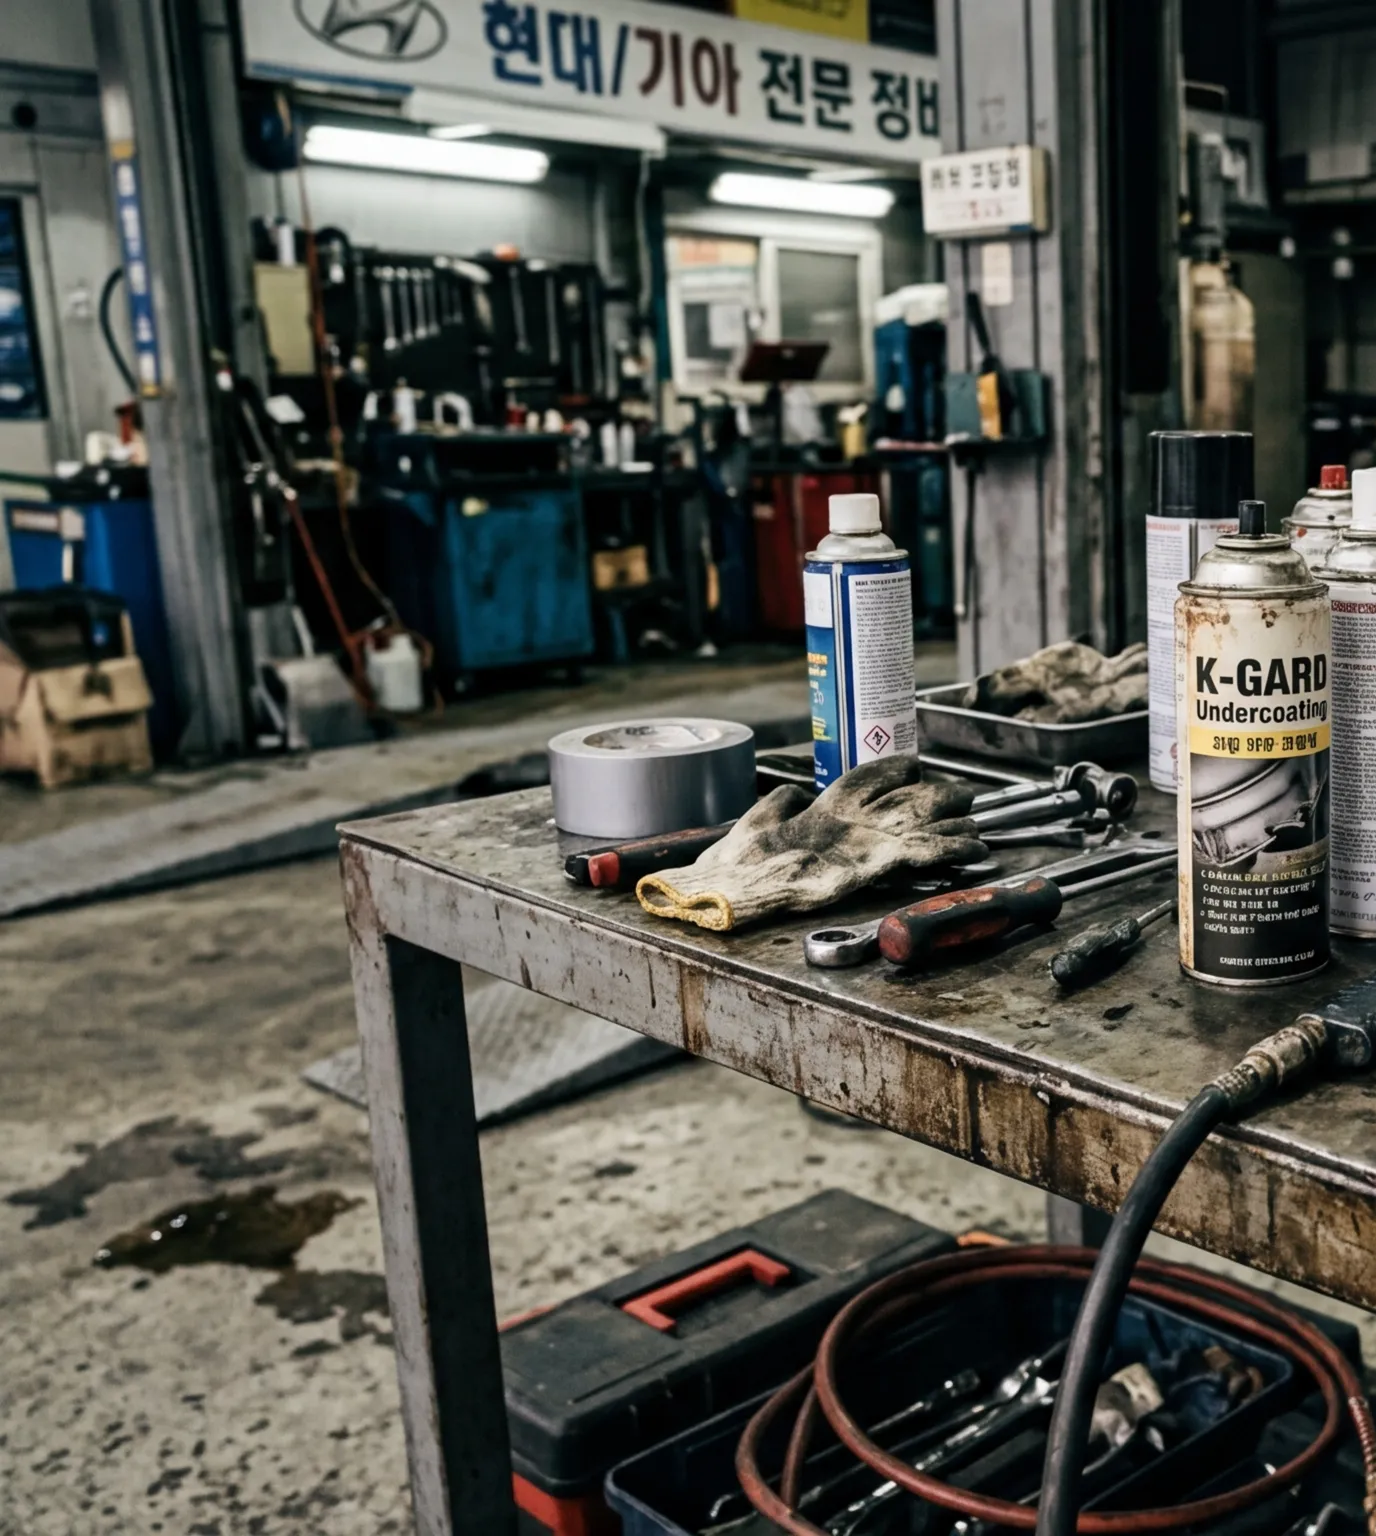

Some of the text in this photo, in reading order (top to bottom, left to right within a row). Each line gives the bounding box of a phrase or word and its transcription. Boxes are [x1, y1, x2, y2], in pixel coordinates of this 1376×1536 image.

[481, 0, 739, 116] 현대/기아
[759, 49, 852, 133] 전문
[1196, 653, 1327, 697] K-GARD
[1196, 698, 1327, 723] Undercoating
